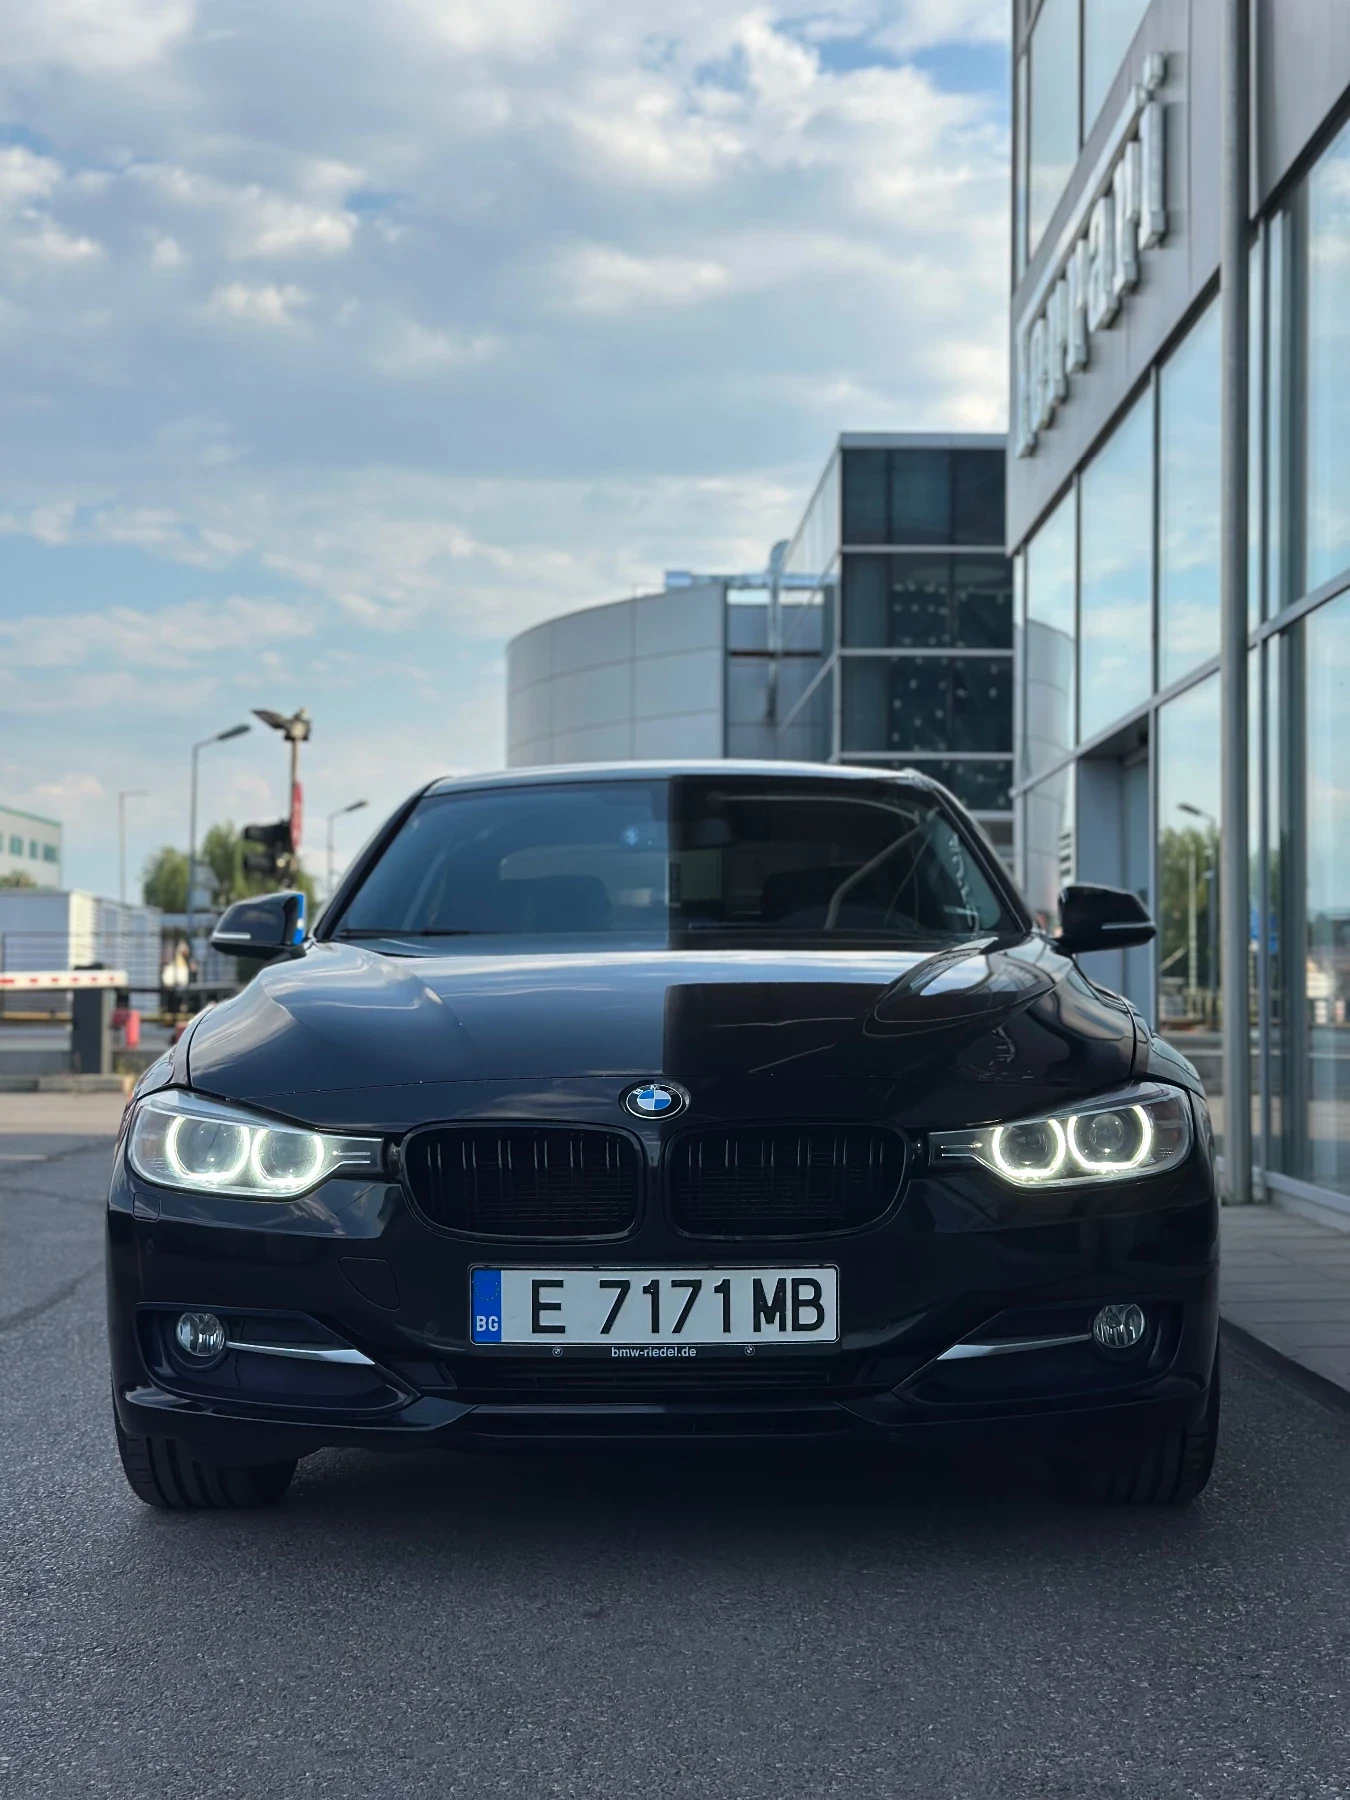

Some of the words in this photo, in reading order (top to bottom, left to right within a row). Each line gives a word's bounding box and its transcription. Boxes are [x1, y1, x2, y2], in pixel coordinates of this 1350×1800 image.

[1016, 53, 1167, 457] Ferrari
[476, 1315, 499, 1332] BG
[531, 1279, 566, 1334] E
[599, 1279, 732, 1334] 7171
[752, 1277, 825, 1334] MB
[611, 1346, 697, 1357] bmw-riedel.de
